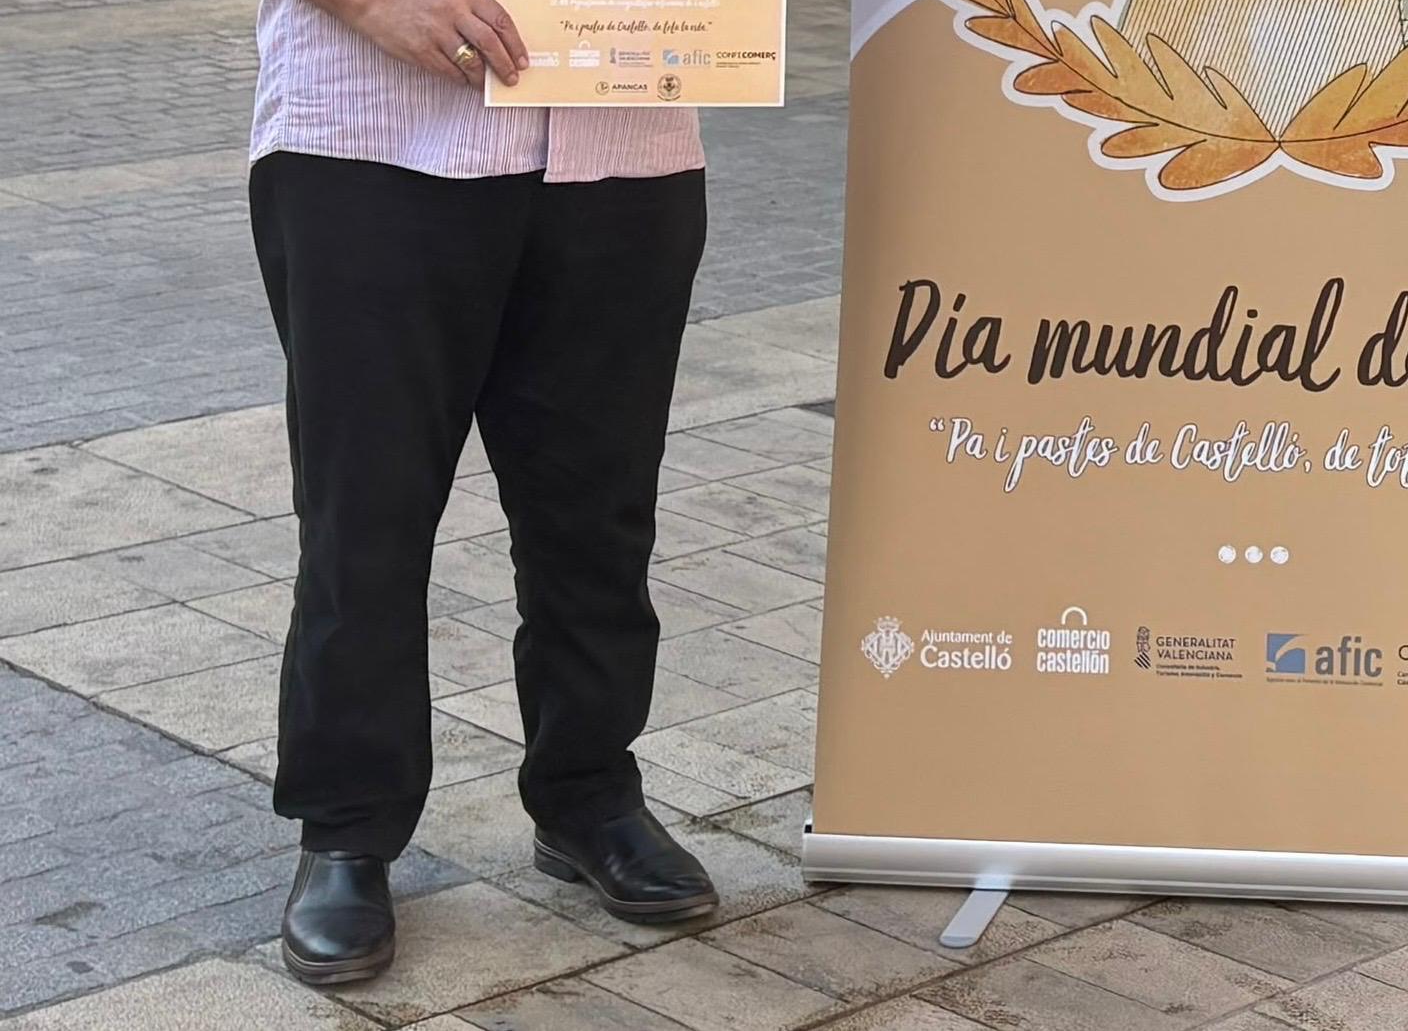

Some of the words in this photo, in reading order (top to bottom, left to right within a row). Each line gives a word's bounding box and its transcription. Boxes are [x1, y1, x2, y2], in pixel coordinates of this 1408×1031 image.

[883, 279, 1011, 379] Día
[1027, 277, 1341, 393] mundial
[994, 428, 1010, 463] i
[1003, 414, 1118, 493] pastes
[1125, 422, 1165, 465] de
[1170, 420, 1312, 483] Castelló,
[1323, 427, 1363, 472] de
[921, 629, 994, 646] Ajuntament
[997, 630, 1014, 645] de
[1037, 627, 1111, 651] comercio
[1156, 636, 1236, 649] GENERALITAT
[920, 645, 1013, 671] Castelló
[1156, 649, 1234, 661] VALENCIANA
[1315, 635, 1383, 678] afic
